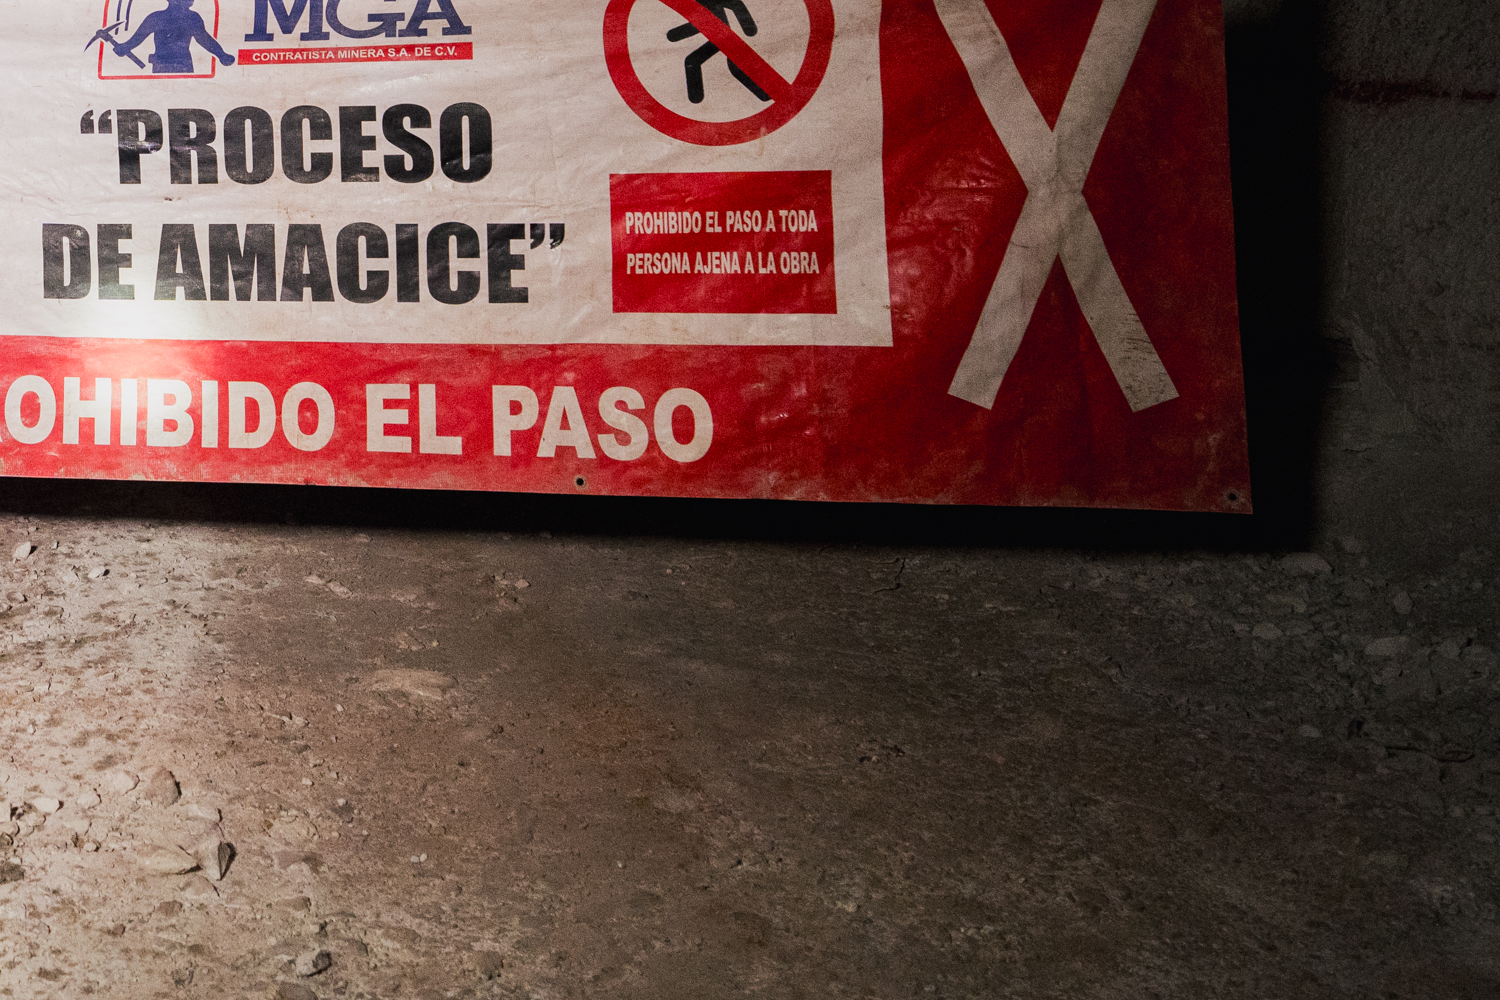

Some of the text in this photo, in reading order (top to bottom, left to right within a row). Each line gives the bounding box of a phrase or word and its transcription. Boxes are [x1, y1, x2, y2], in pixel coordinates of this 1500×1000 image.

[252, 45, 458, 62] CONTRATISTA MINERA S.A. DE C.V.
[79, 102, 493, 184] “PROCESO
[625, 209, 818, 234] PROHIBIDO EL PASO A TODA
[42, 222, 565, 304] DE AMACICE”
[626, 251, 820, 275] PERSONA AJENA A LA OBRA
[365, 382, 463, 456] EL
[491, 384, 715, 464] PASO
